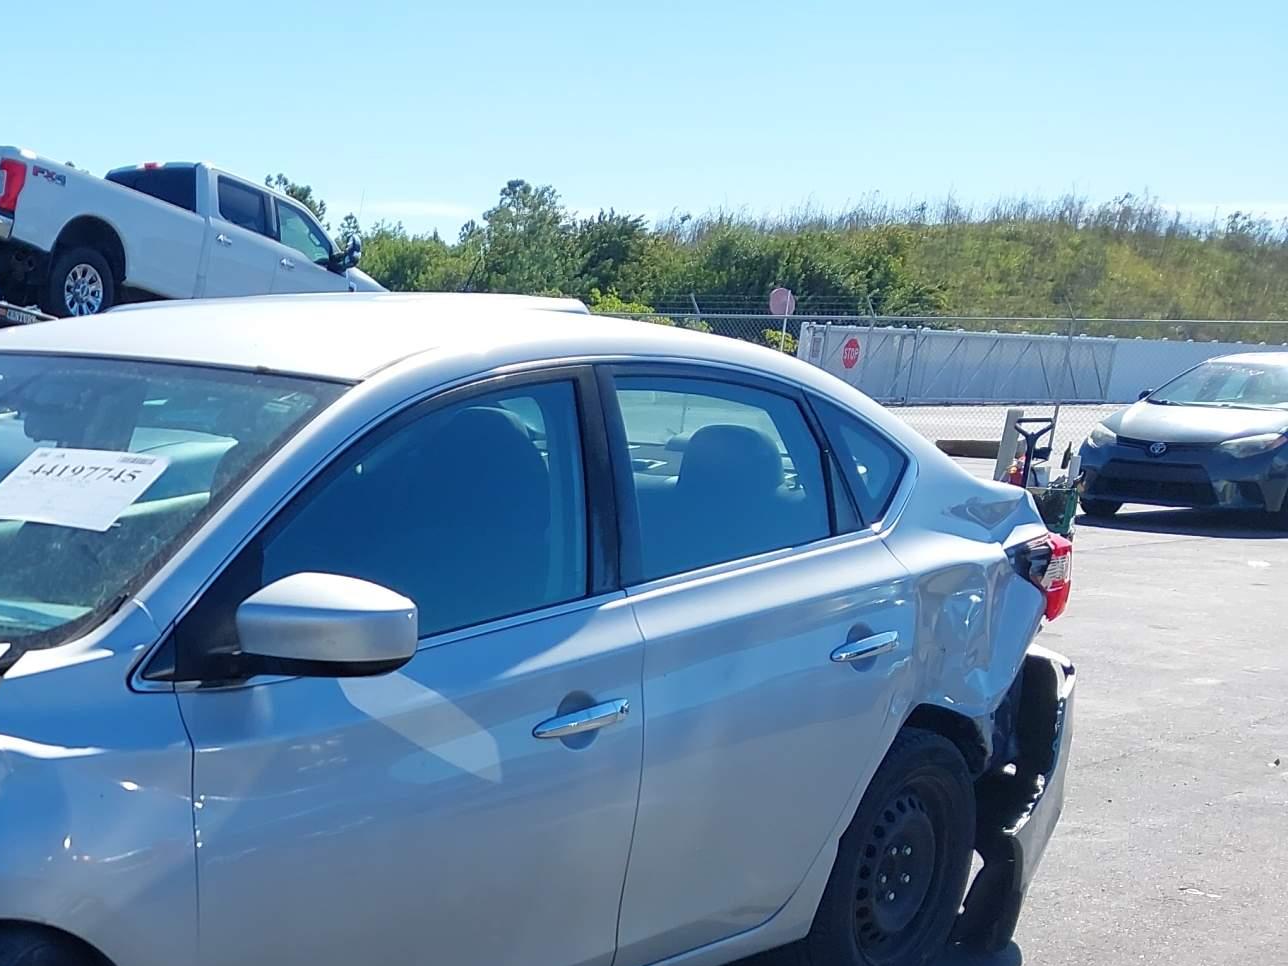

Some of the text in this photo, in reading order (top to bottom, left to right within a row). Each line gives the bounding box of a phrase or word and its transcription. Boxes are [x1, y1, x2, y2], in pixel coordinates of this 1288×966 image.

[32, 165, 66, 187] FX4
[843, 347, 860, 361] STOP
[29, 463, 142, 483] 44197745
